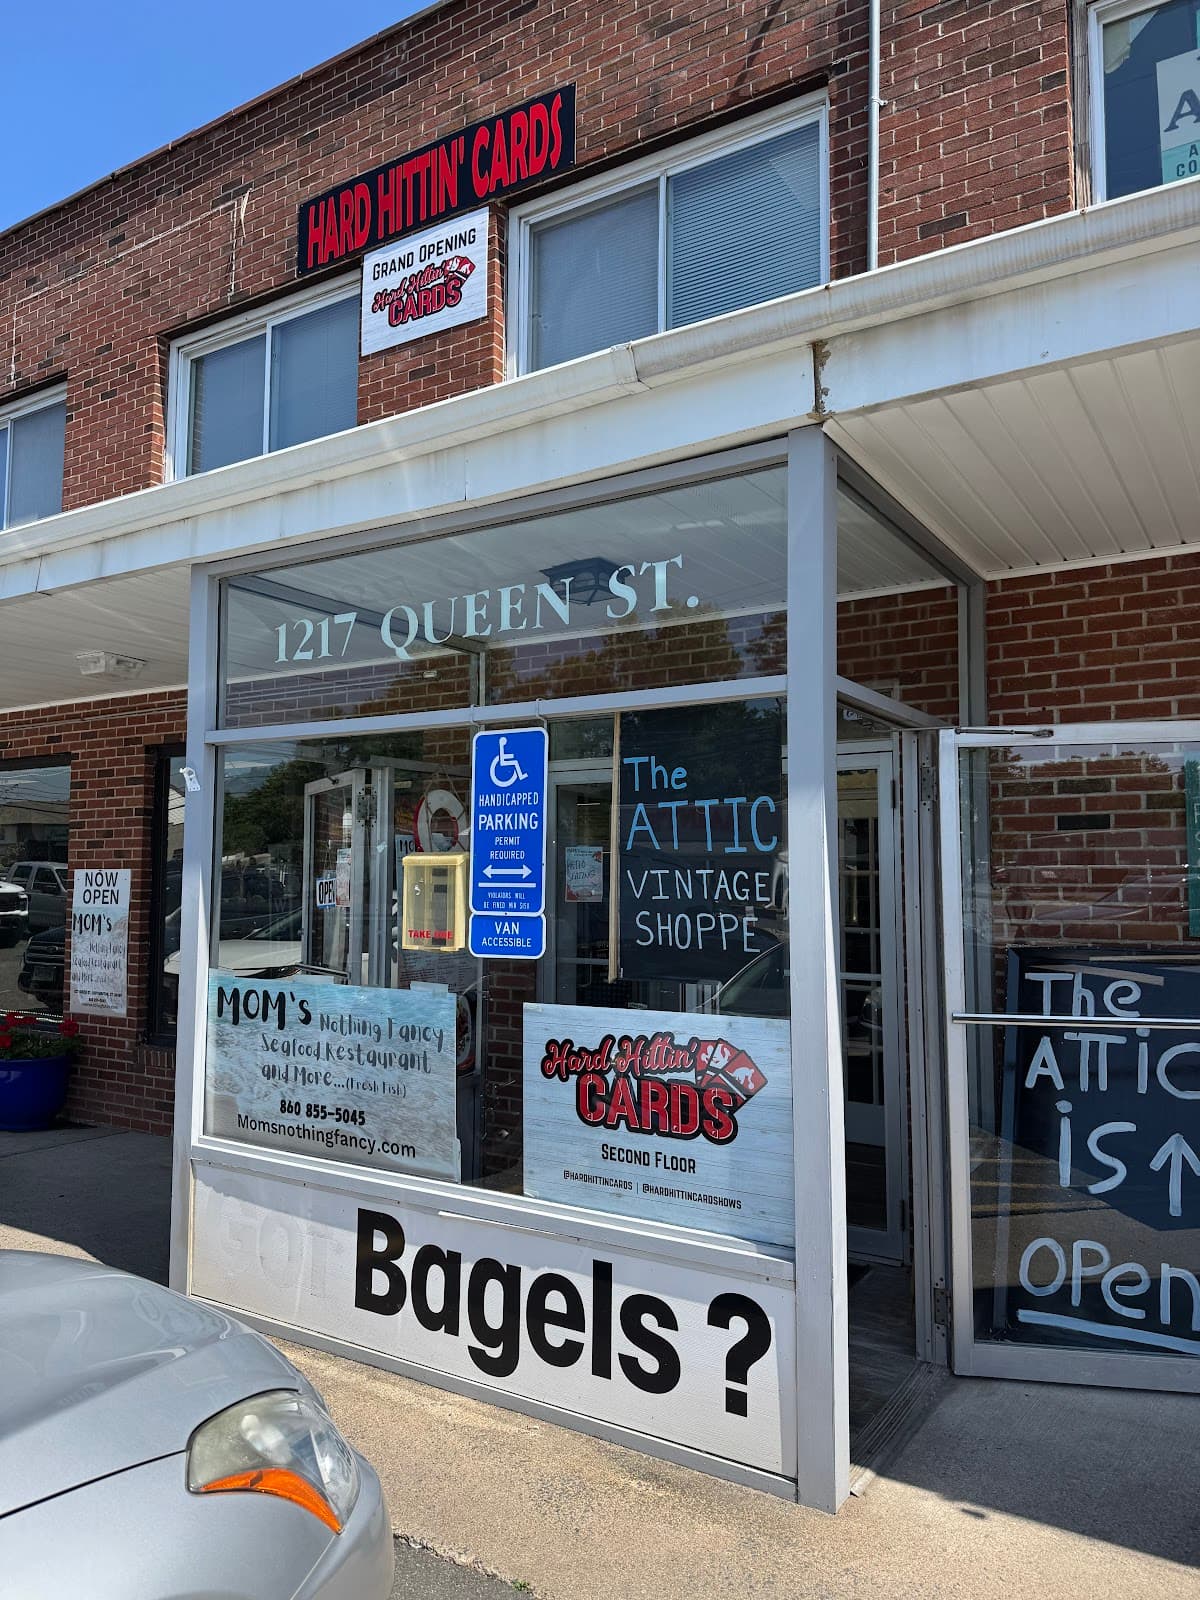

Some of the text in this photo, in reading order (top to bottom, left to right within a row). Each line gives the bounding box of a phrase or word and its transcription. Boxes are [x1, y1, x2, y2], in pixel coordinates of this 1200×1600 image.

[307, 92, 563, 268] HARD HITTIN' CARDS
[373, 228, 476, 280] GRAND OPENING
[372, 277, 408, 313] Hard
[389, 280, 462, 327] CARDS
[274, 554, 699, 663] 1217 QUEEN ST.
[623, 756, 688, 791] The
[479, 792, 538, 807] HANDICAPPED
[478, 812, 539, 831] PARKING
[626, 796, 777, 853] ATTIC
[490, 850, 525, 860] REQUIRED
[495, 836, 520, 846] PERMIT
[83, 889, 119, 905] OPEN
[85, 872, 119, 887] NOW
[627, 870, 770, 902] VINTAGE
[73, 913, 112, 936] MOM's
[408, 929, 431, 939] TAKE
[495, 921, 519, 935] VAN
[636, 911, 761, 953] SHOPPE
[481, 937, 532, 948] ACCESSIBLE
[1024, 971, 1142, 1017] The
[217, 986, 444, 1053] MOM's Nothing Fancy
[261, 1032, 431, 1074] Seafood Restaurant
[541, 1032, 698, 1081] Hard Hittin'
[262, 1064, 289, 1083] and
[280, 1100, 366, 1126] 860 855-5045
[576, 1073, 738, 1145] CARDS
[238, 1114, 416, 1158] Momsnothingfancy.com
[601, 1143, 696, 1174] SECOND FLOOR
[563, 1169, 742, 1209] @HARDHITTINCARDS @HARDHITTINCARDSHOWS
